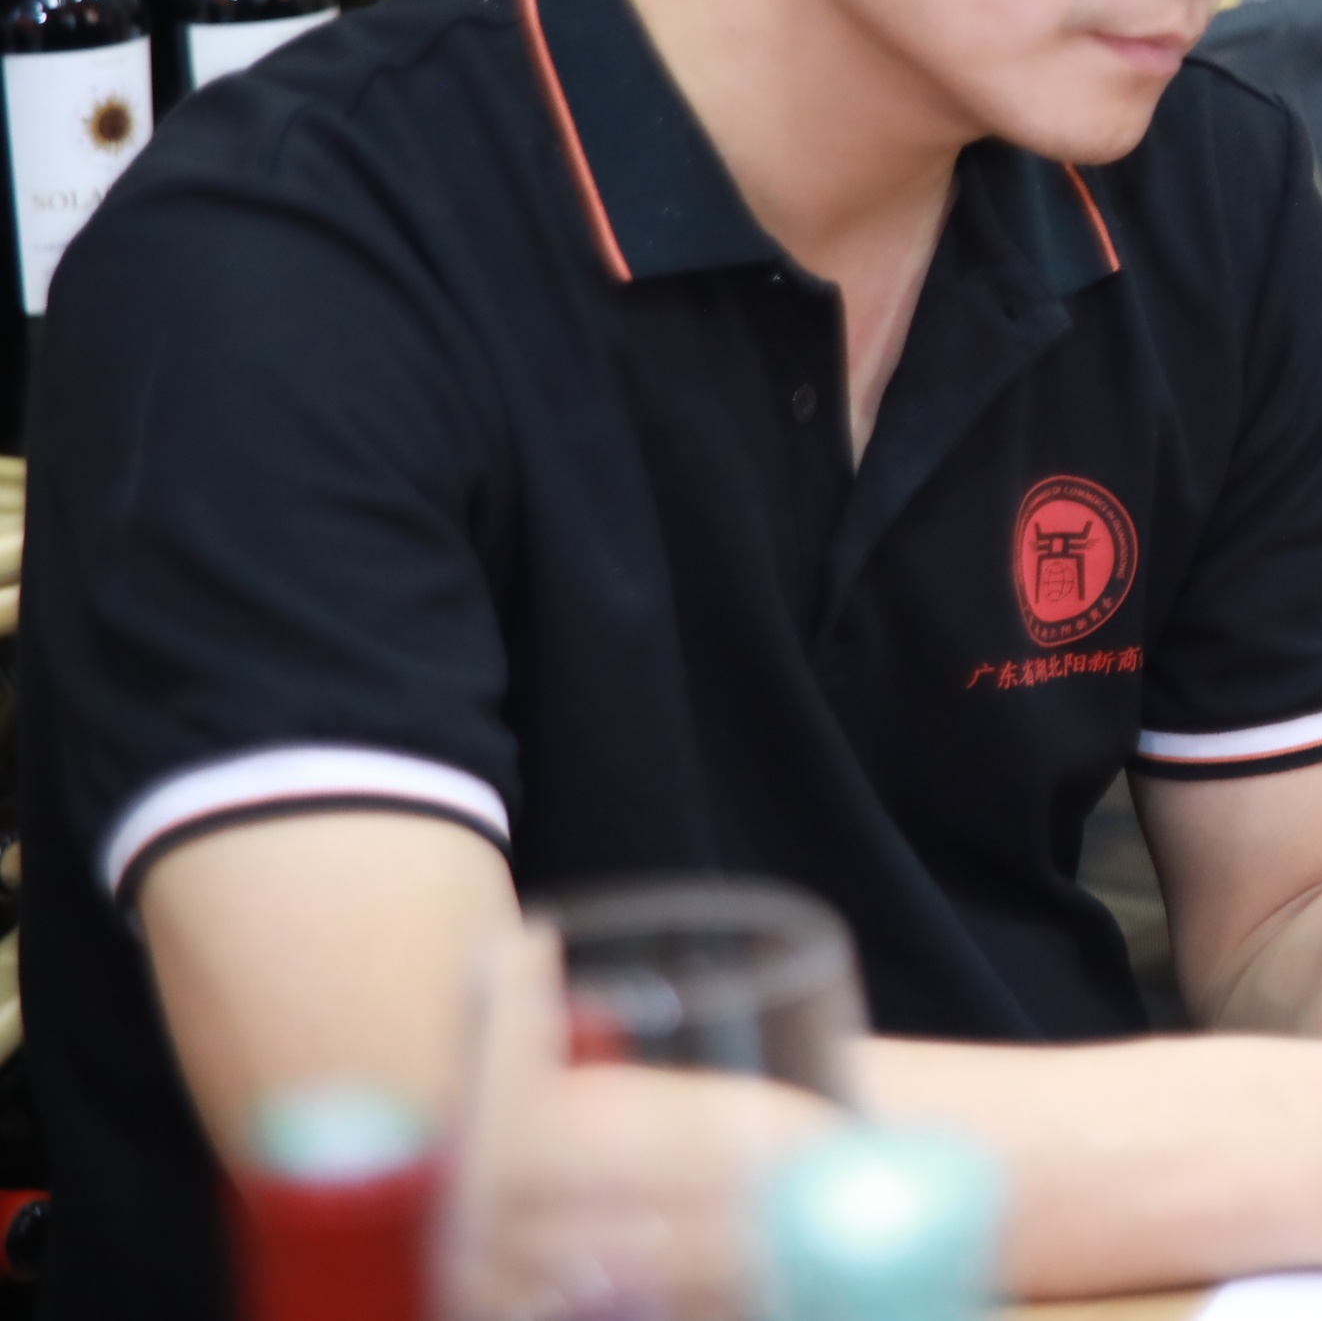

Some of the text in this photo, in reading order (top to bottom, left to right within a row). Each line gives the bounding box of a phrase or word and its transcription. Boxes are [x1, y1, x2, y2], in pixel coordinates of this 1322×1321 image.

[32, 187, 104, 212] SOLA
[966, 646, 1143, 689] 广东省湖北阳新商
